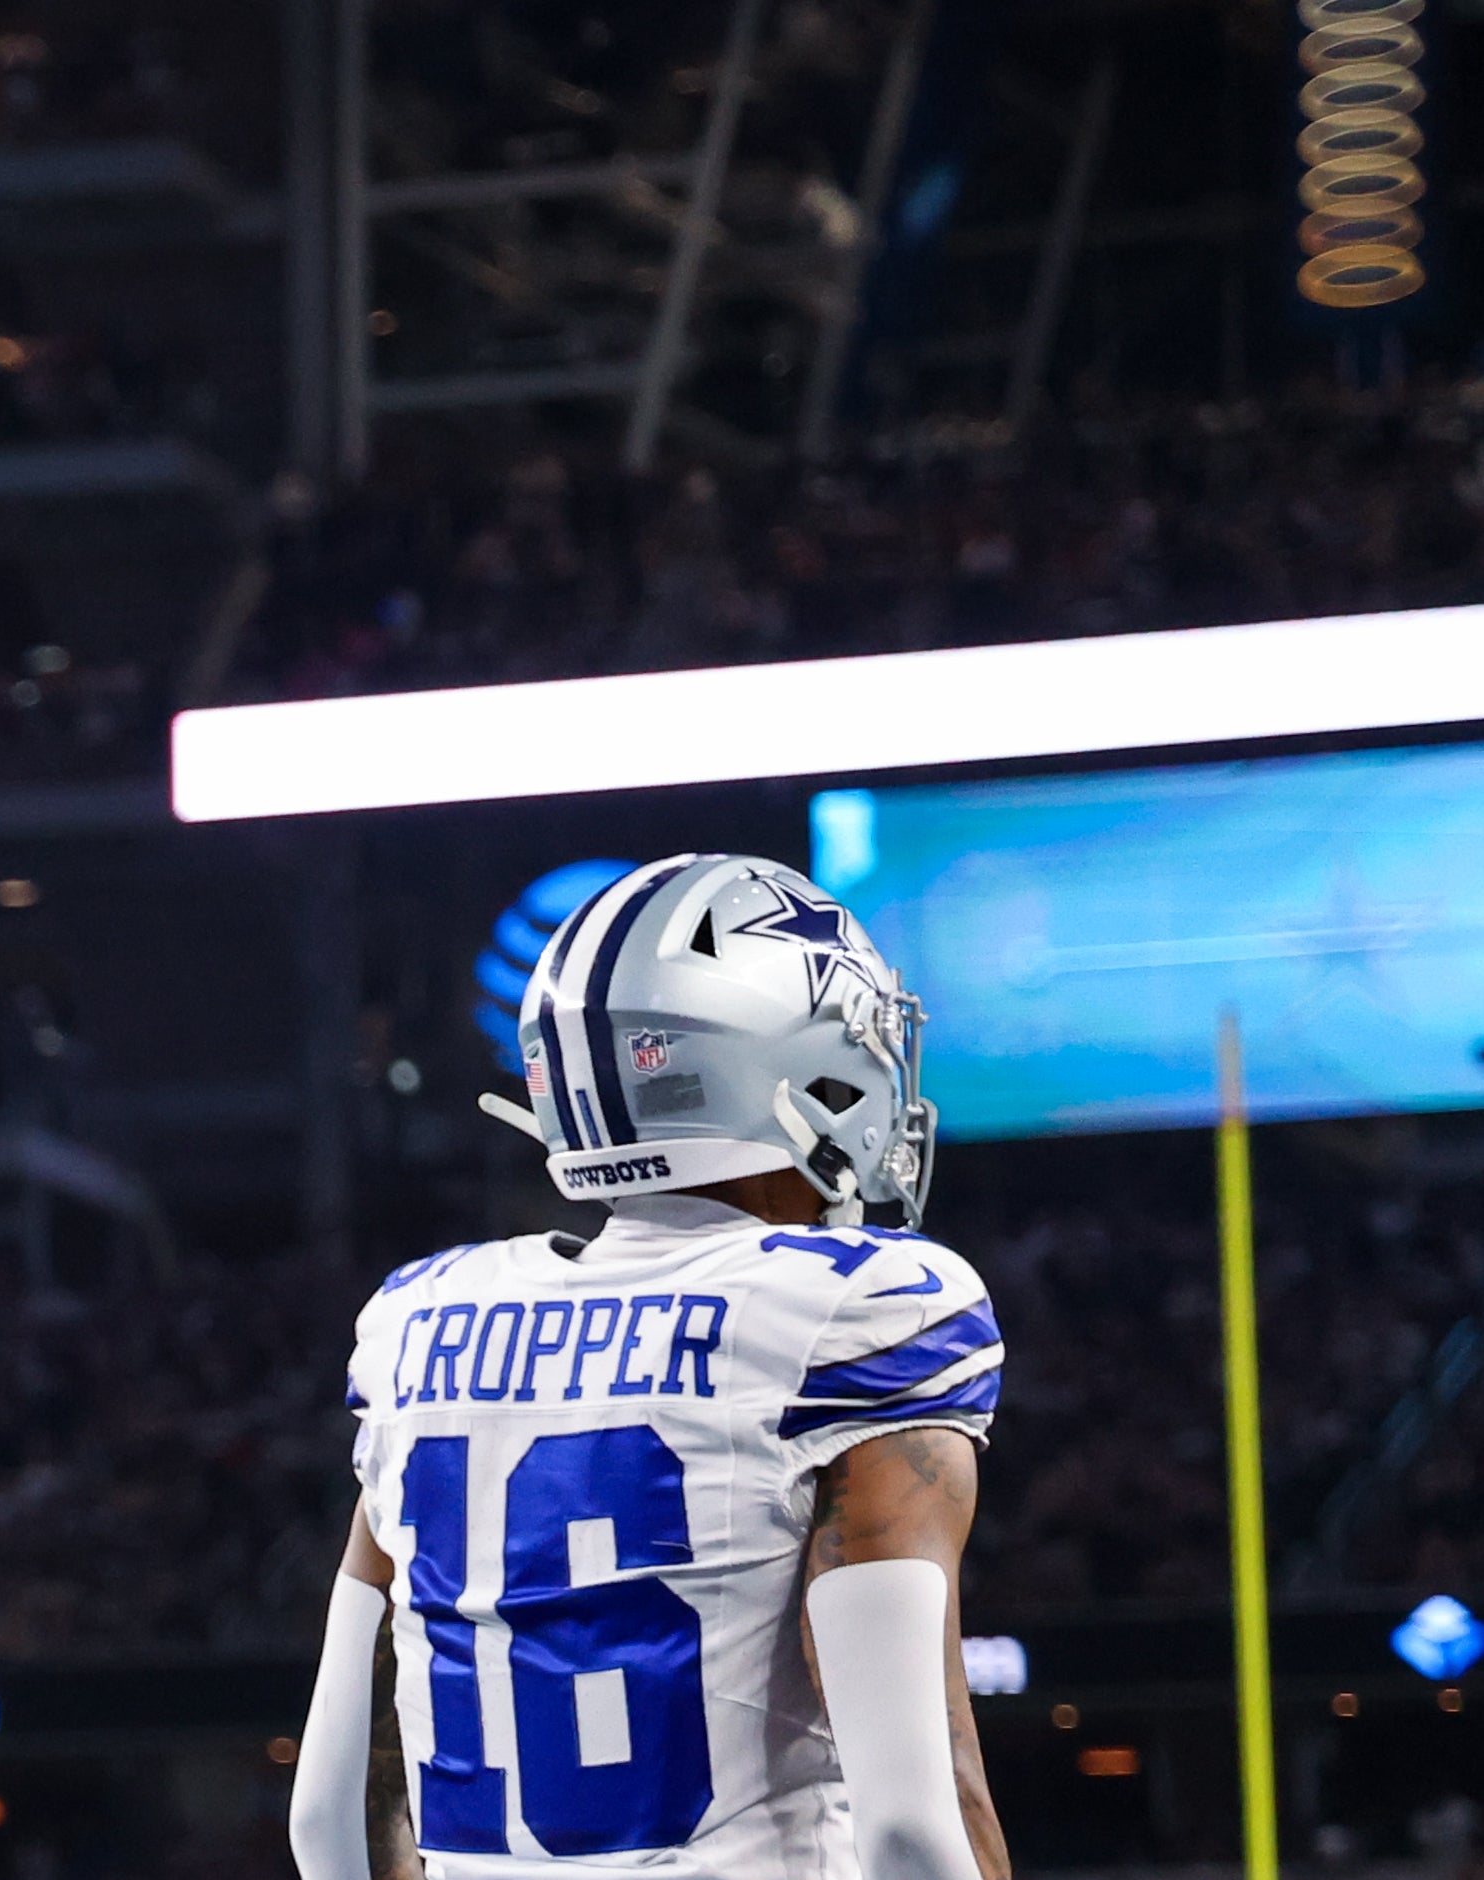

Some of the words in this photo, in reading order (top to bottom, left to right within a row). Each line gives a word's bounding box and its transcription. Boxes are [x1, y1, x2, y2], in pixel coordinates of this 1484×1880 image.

[635, 1048, 667, 1070] NFL
[562, 1155, 671, 1189] COWBOYS
[393, 1294, 729, 1410] CROPPER
[399, 1424, 715, 1857] 16
